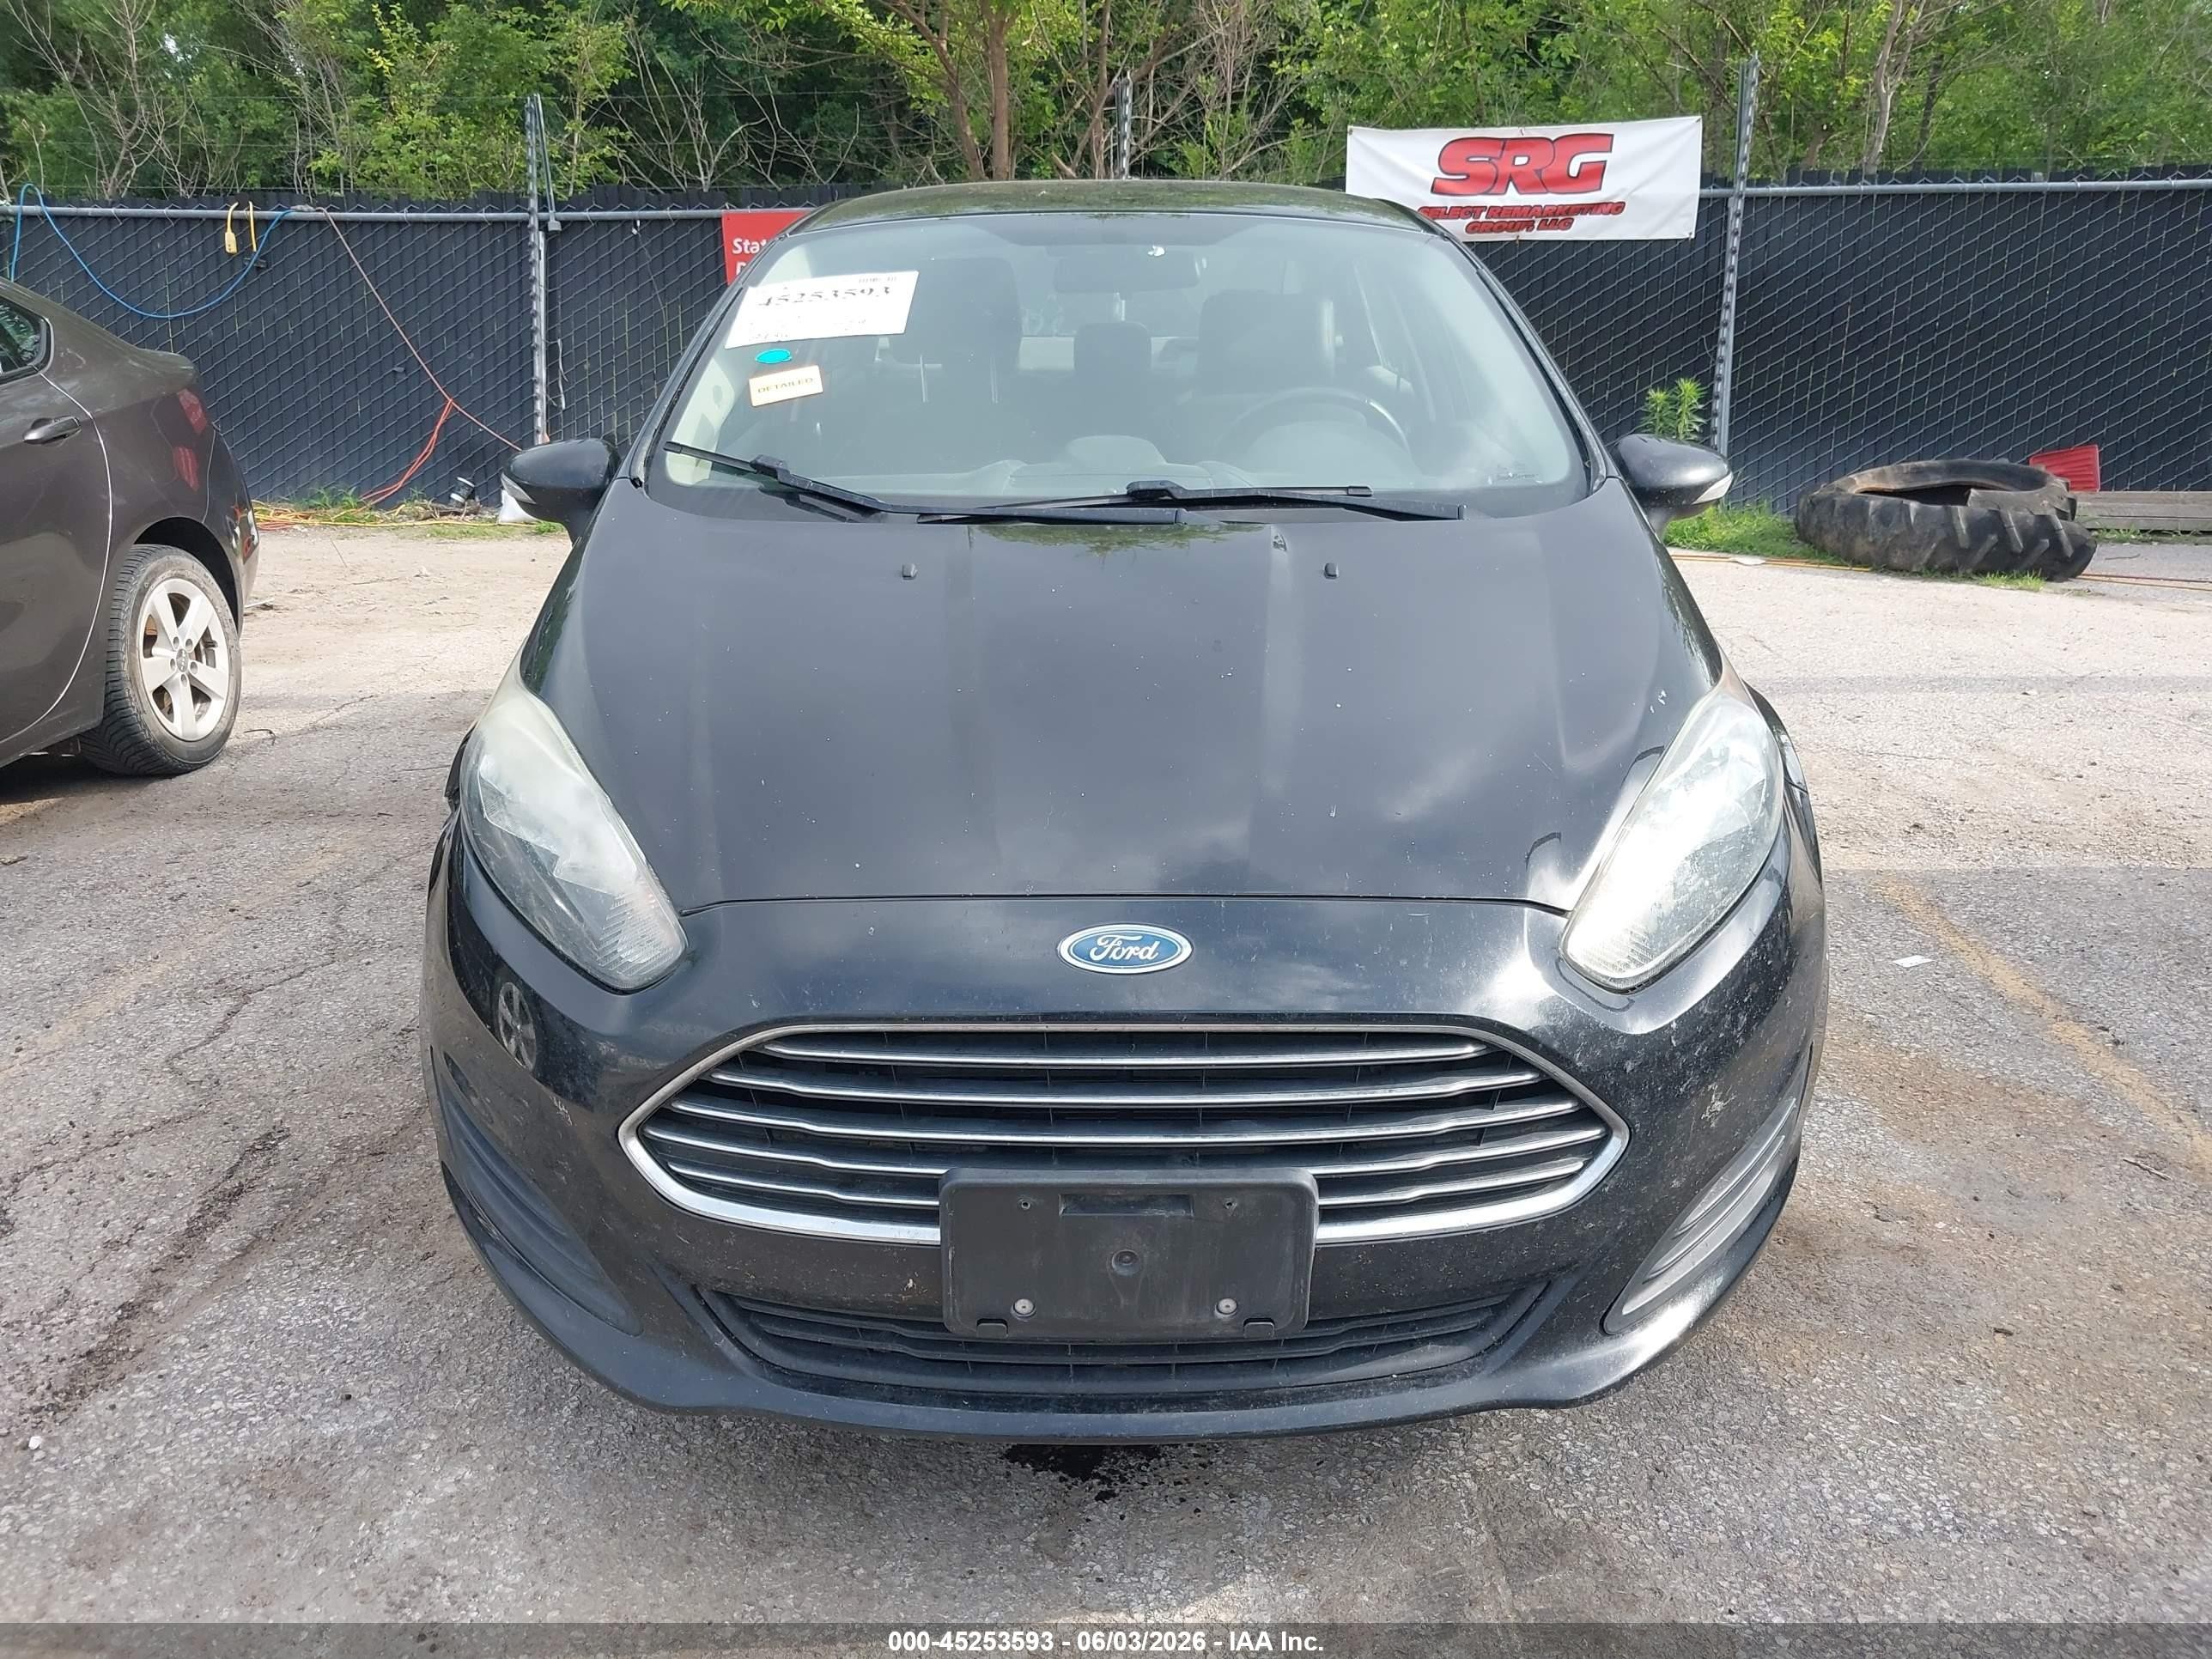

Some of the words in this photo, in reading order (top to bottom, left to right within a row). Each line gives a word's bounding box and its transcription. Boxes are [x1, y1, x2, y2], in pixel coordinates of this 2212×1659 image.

[1431, 133, 1614, 196] SRG
[1418, 206, 1487, 220] SELECT
[1486, 201, 1626, 219] REMARKETING
[1466, 220, 1534, 234] GROUP,
[1537, 217, 1575, 231] LLC
[757, 377, 814, 393] DETAILED
[1089, 934, 1161, 961] Ford
